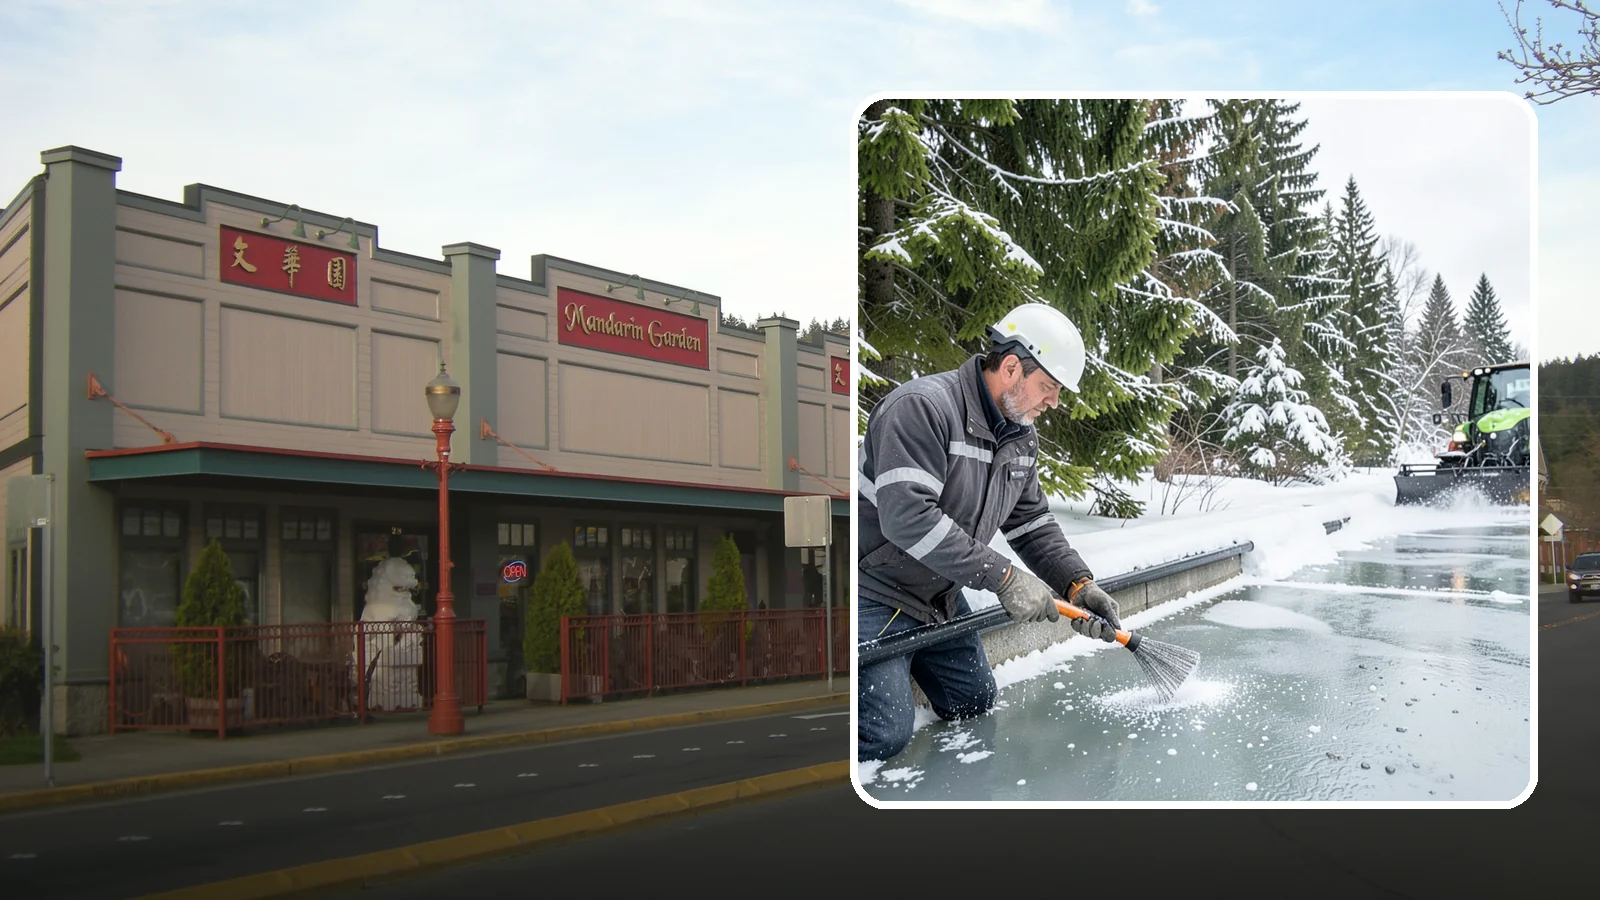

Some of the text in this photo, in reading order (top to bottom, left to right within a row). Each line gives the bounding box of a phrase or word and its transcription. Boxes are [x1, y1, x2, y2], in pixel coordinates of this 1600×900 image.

[230, 236, 346, 291] 文華園
[564, 302, 701, 352] Mandarin Garden
[503, 565, 527, 578] OPEN
